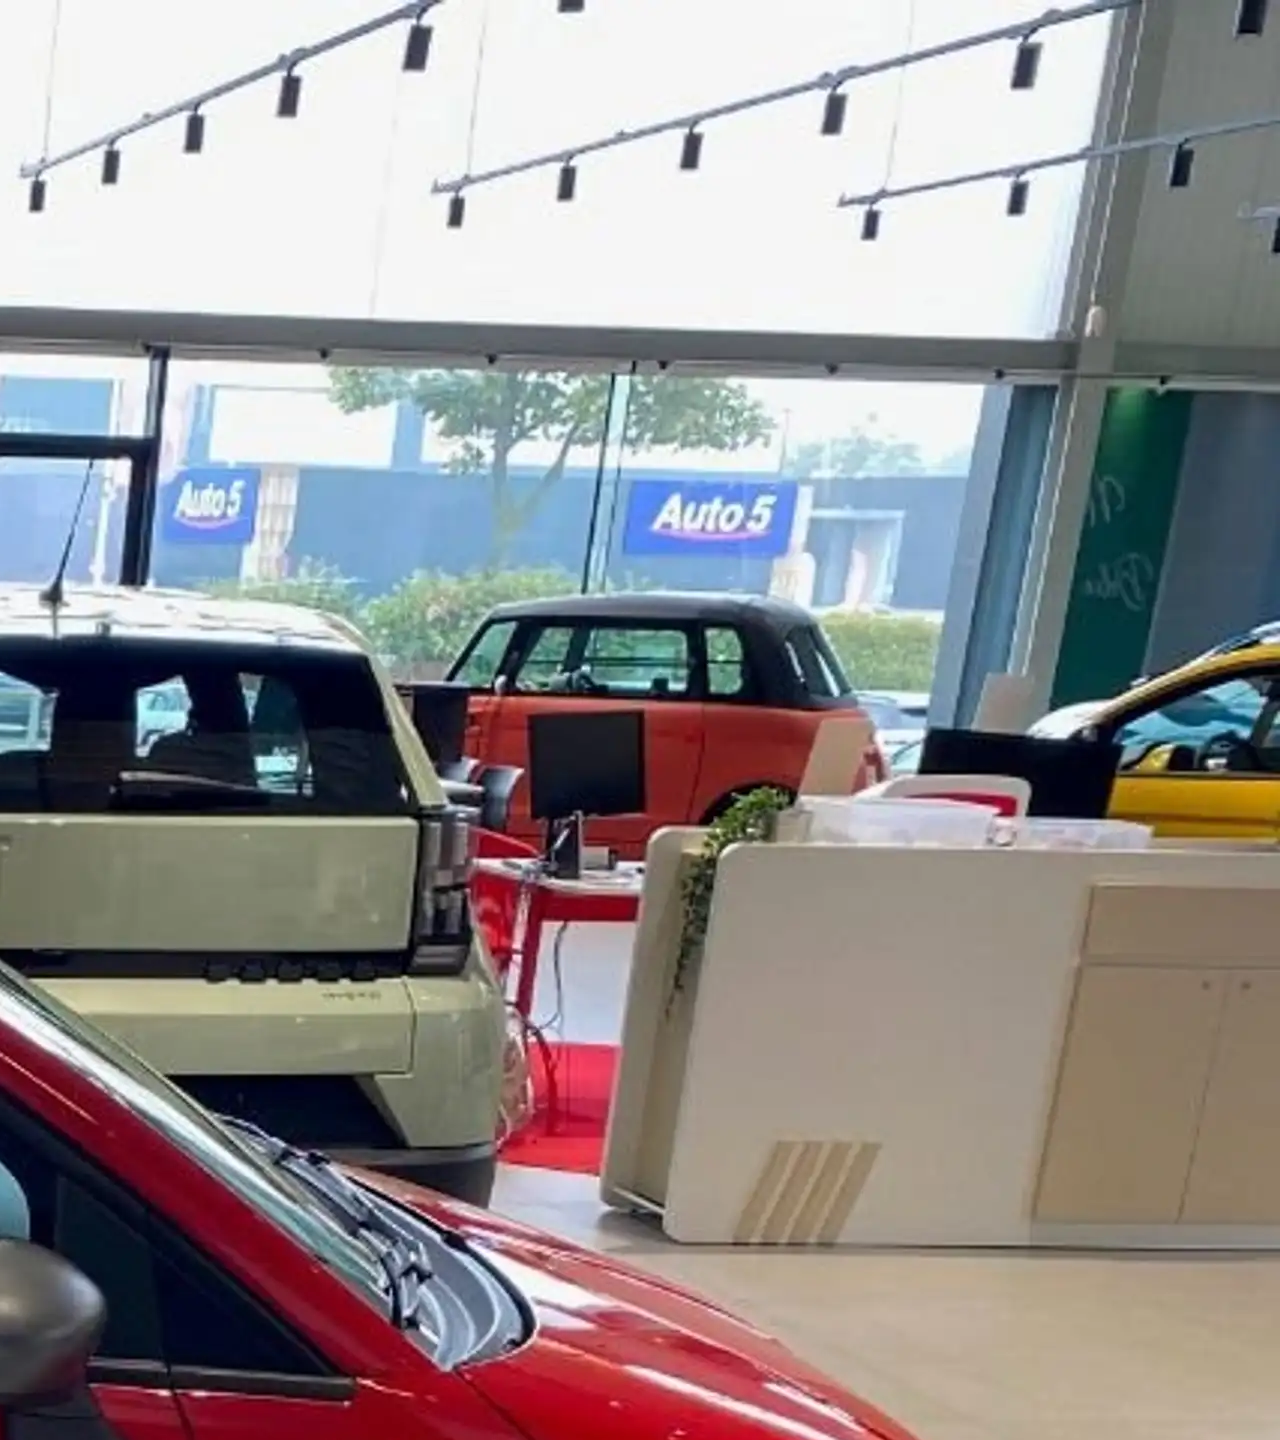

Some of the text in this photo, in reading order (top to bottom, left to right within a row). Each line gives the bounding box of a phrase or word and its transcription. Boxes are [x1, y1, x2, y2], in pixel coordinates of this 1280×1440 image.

[174, 480, 246, 518] Auto 5
[651, 492, 777, 533] Auto 5
